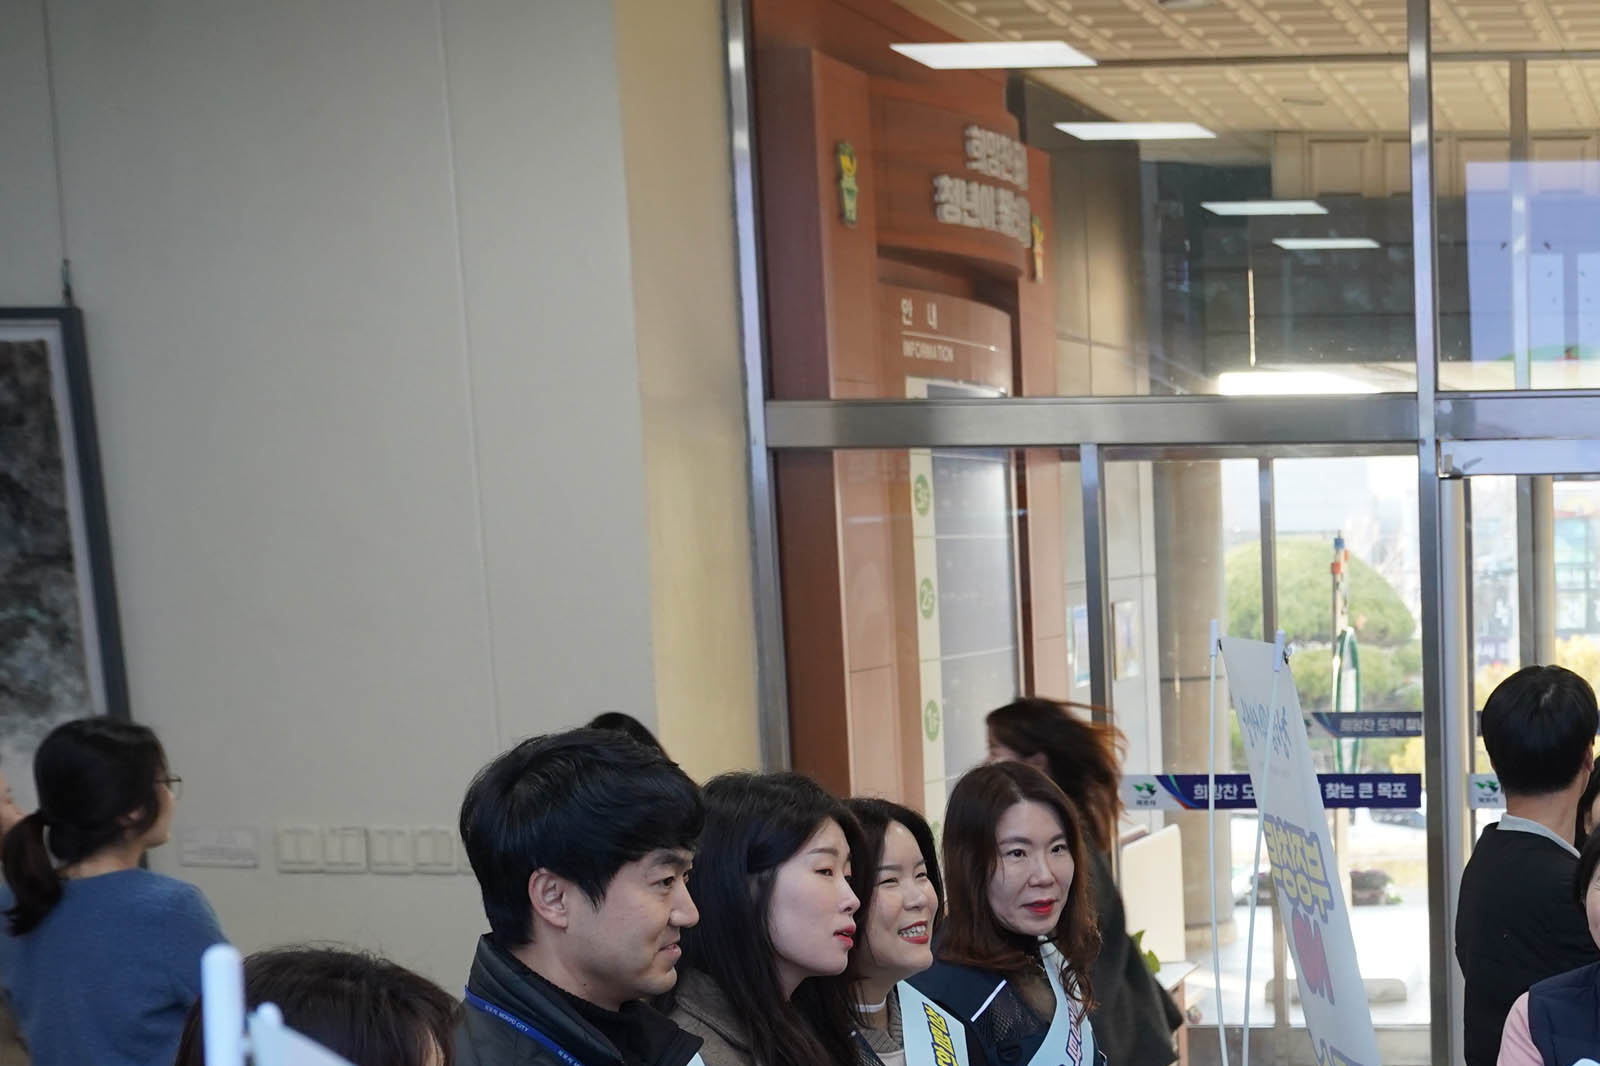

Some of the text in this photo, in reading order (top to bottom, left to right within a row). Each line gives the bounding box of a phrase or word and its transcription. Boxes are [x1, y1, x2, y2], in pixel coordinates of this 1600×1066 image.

[1325, 783, 1407, 799] 찾는 큰 목포
